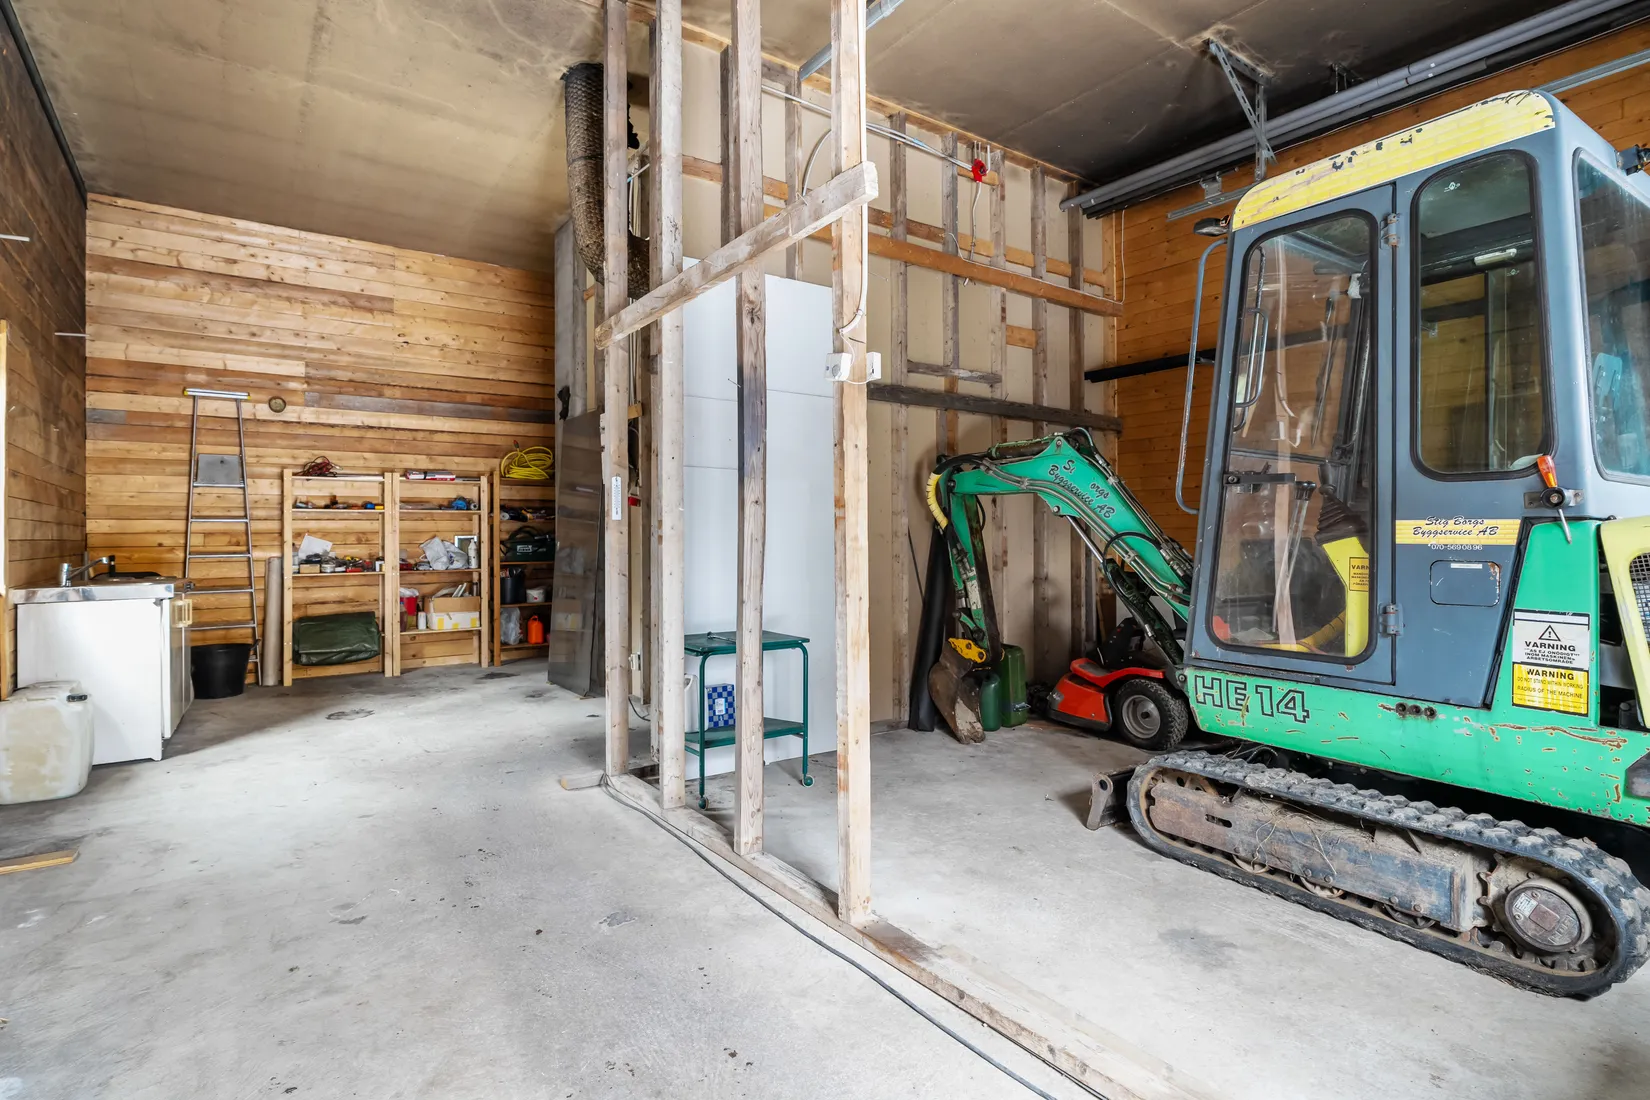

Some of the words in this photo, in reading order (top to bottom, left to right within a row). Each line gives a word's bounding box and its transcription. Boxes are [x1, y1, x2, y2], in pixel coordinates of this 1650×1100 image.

[1048, 464, 1095, 506] Byggservice
[1093, 503, 1116, 518] AB
[1425, 515, 1449, 528] Stig
[1453, 515, 1485, 528] Borgs
[1412, 526, 1473, 538] Byggservice
[1476, 526, 1499, 537] AB
[1524, 640, 1576, 652] VARNING
[1526, 668, 1575, 681] WARNING
[1517, 685, 1537, 693] RADIUS
[1558, 690, 1583, 699] MACHINE
[1563, 682, 1584, 690] WORKING
